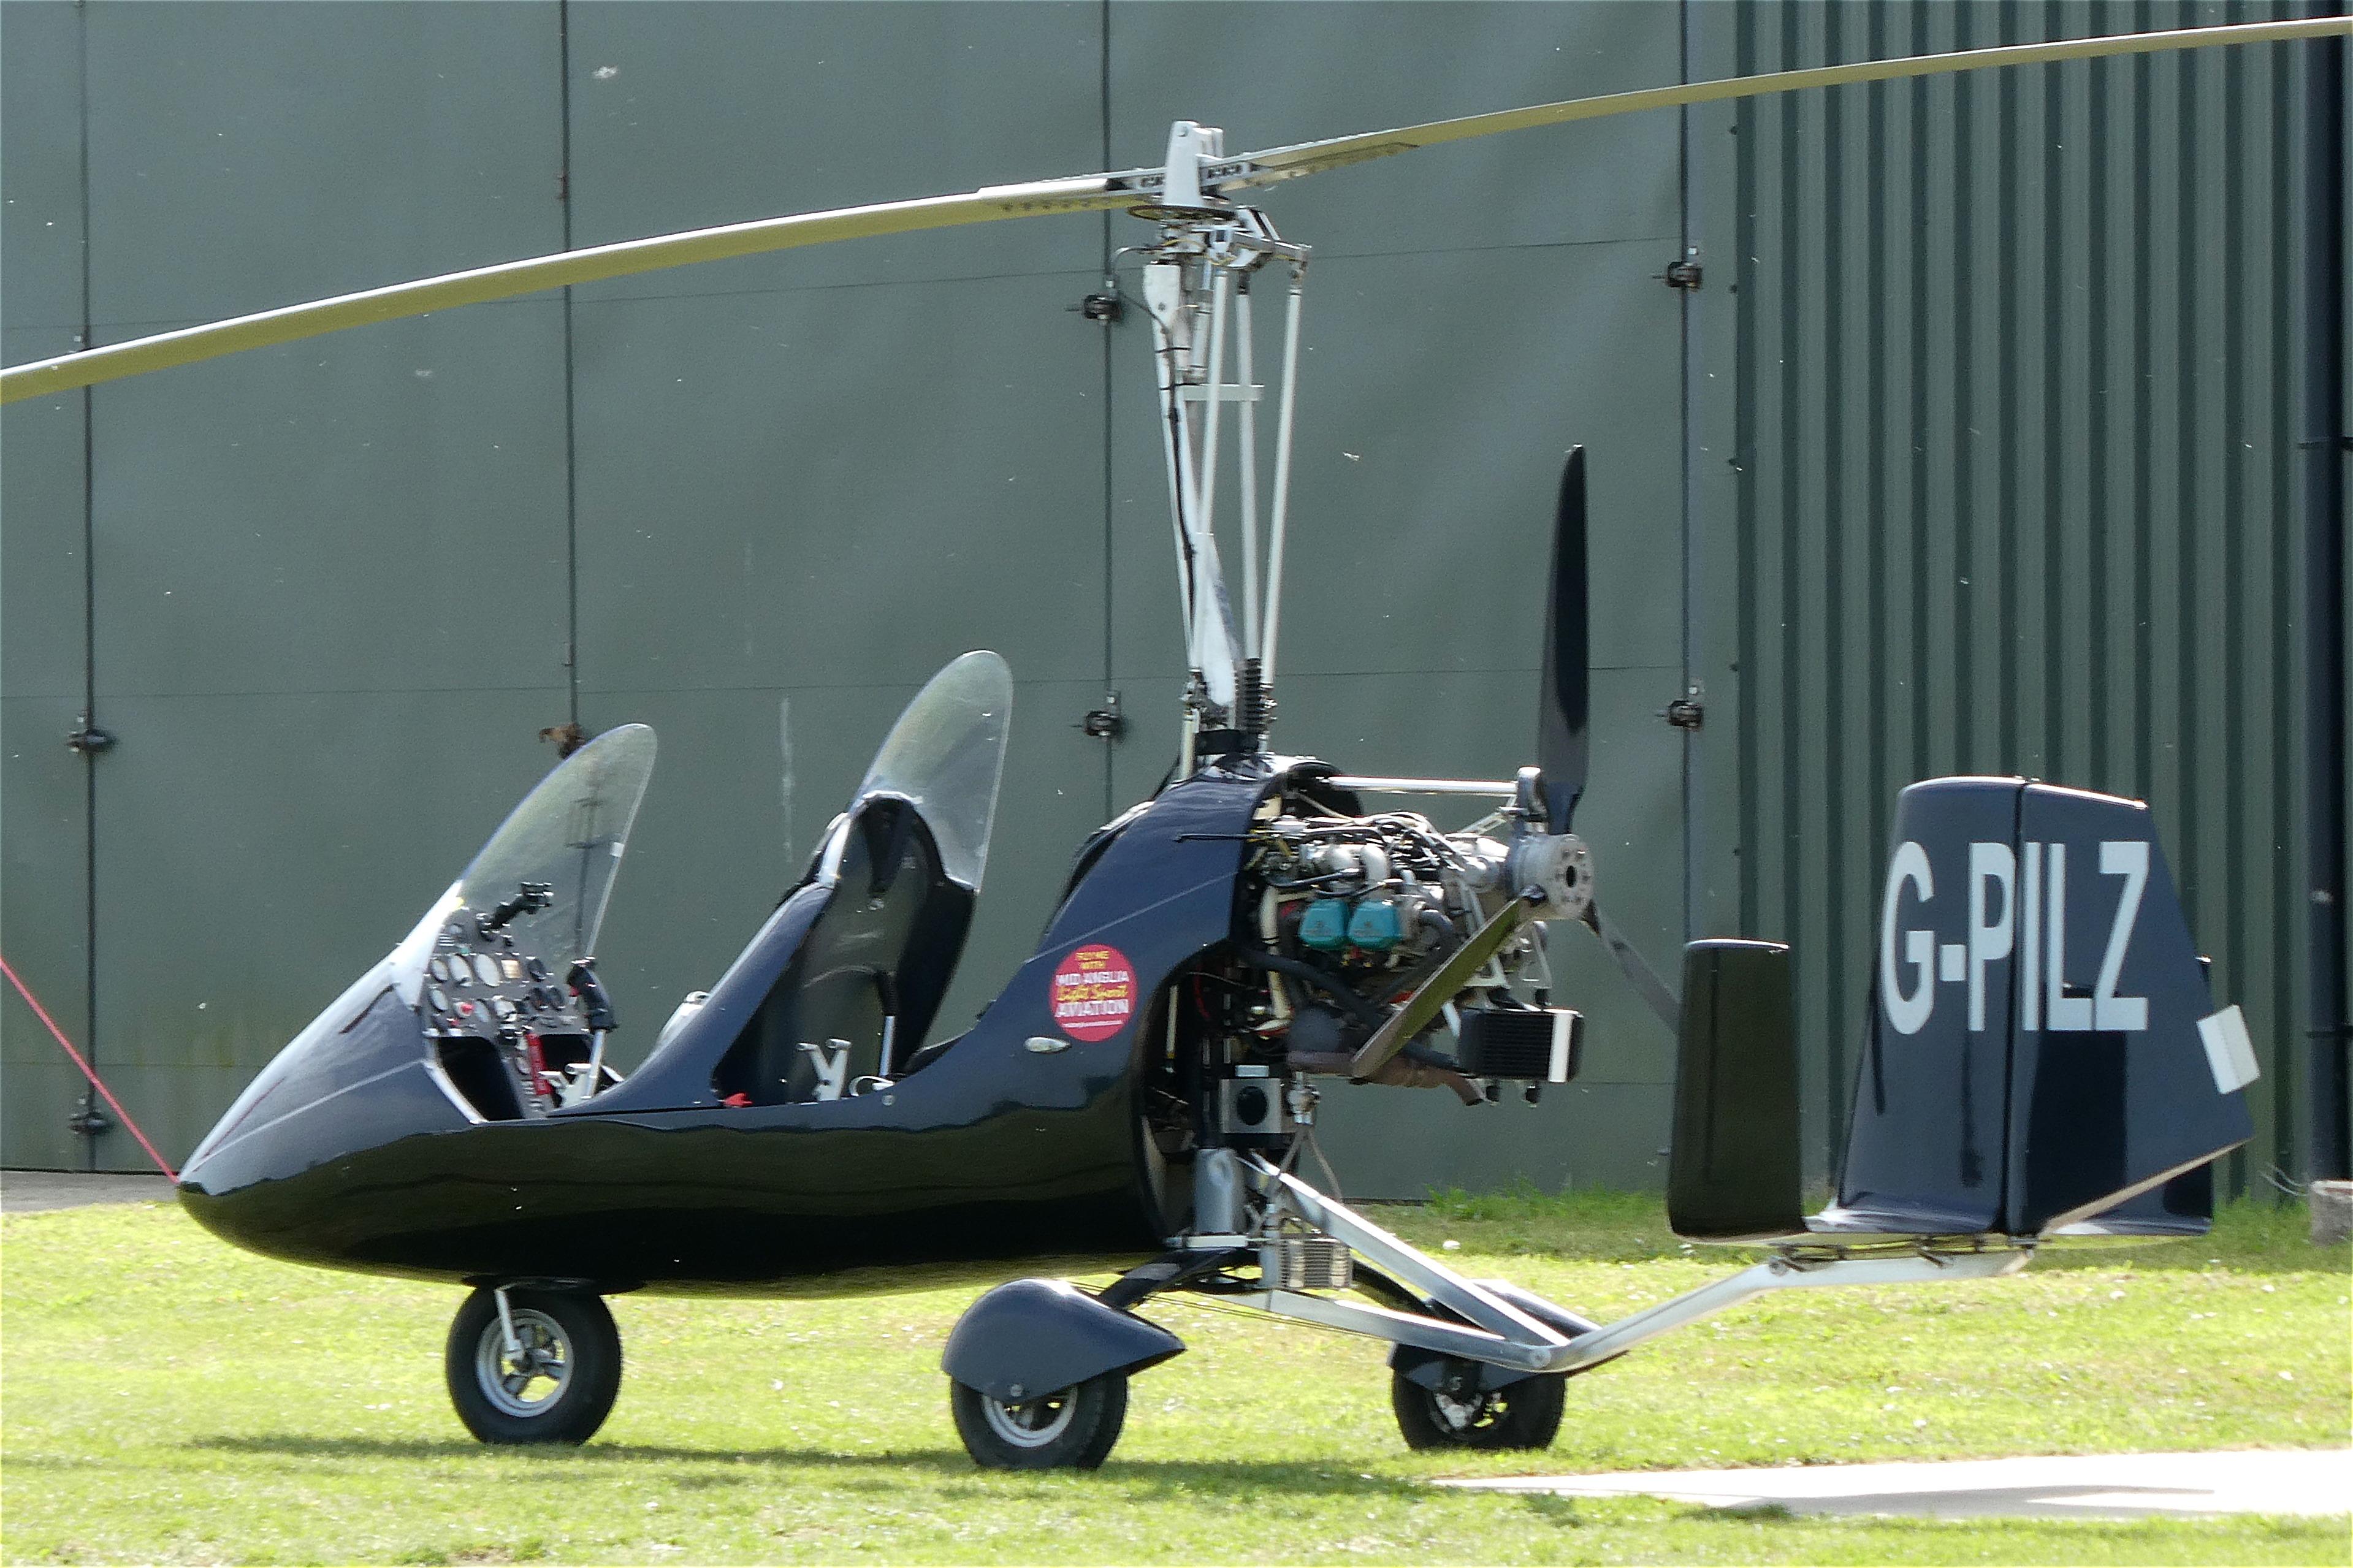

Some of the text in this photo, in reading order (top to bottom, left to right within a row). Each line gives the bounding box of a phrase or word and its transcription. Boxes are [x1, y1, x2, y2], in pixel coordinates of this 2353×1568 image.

[1881, 841, 2149, 1034] G-PILZ
[1080, 961, 1105, 970] WITH
[1056, 970, 1129, 986] MID ANGLIA
[1054, 999, 1129, 1018] AVIATION
